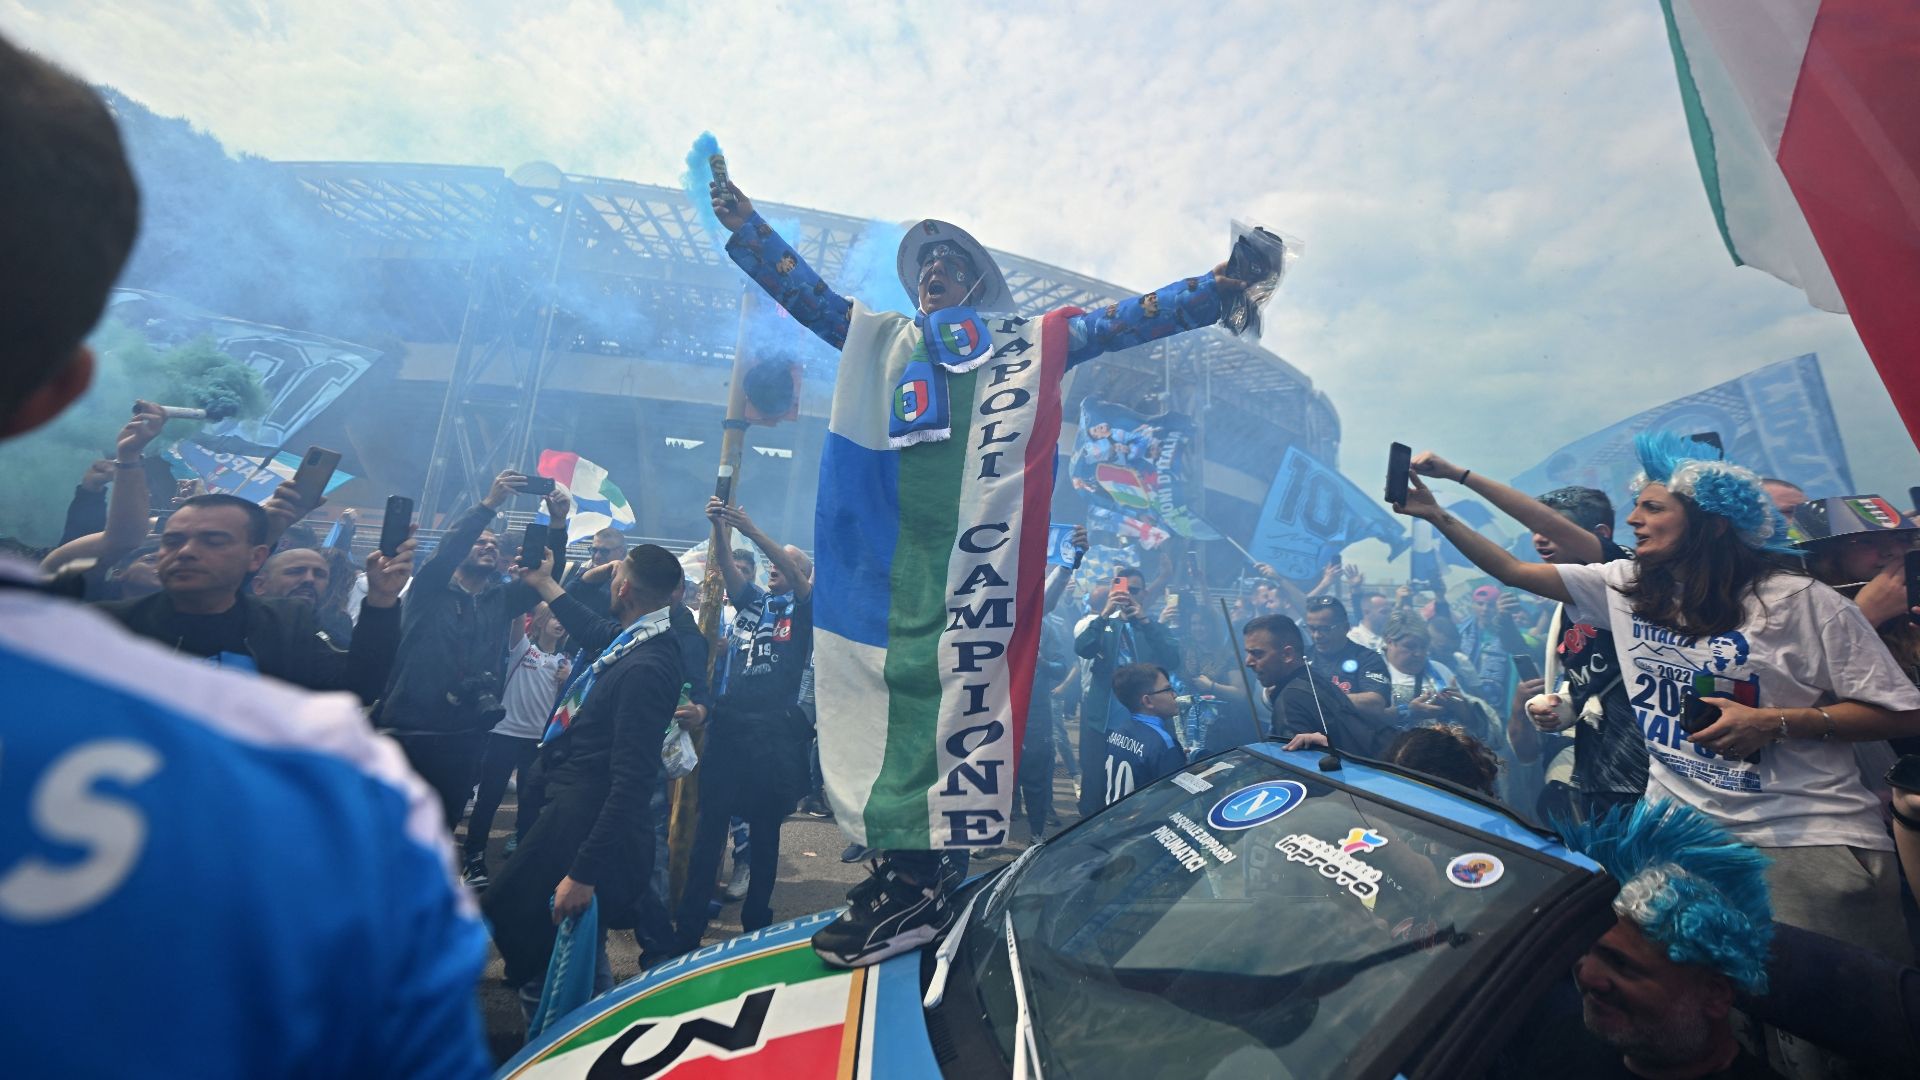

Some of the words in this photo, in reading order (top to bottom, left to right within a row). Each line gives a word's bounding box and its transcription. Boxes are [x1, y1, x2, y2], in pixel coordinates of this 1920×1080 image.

[1275, 452, 1348, 541] 10
[940, 522, 1014, 847] CAMPIONE
[1658, 665, 1691, 684] 2022
[1107, 732, 1145, 757] MARADONA
[1105, 754, 1135, 806] 10
[1231, 789, 1283, 817] N
[1150, 825, 1208, 873] PNEUMATICI
